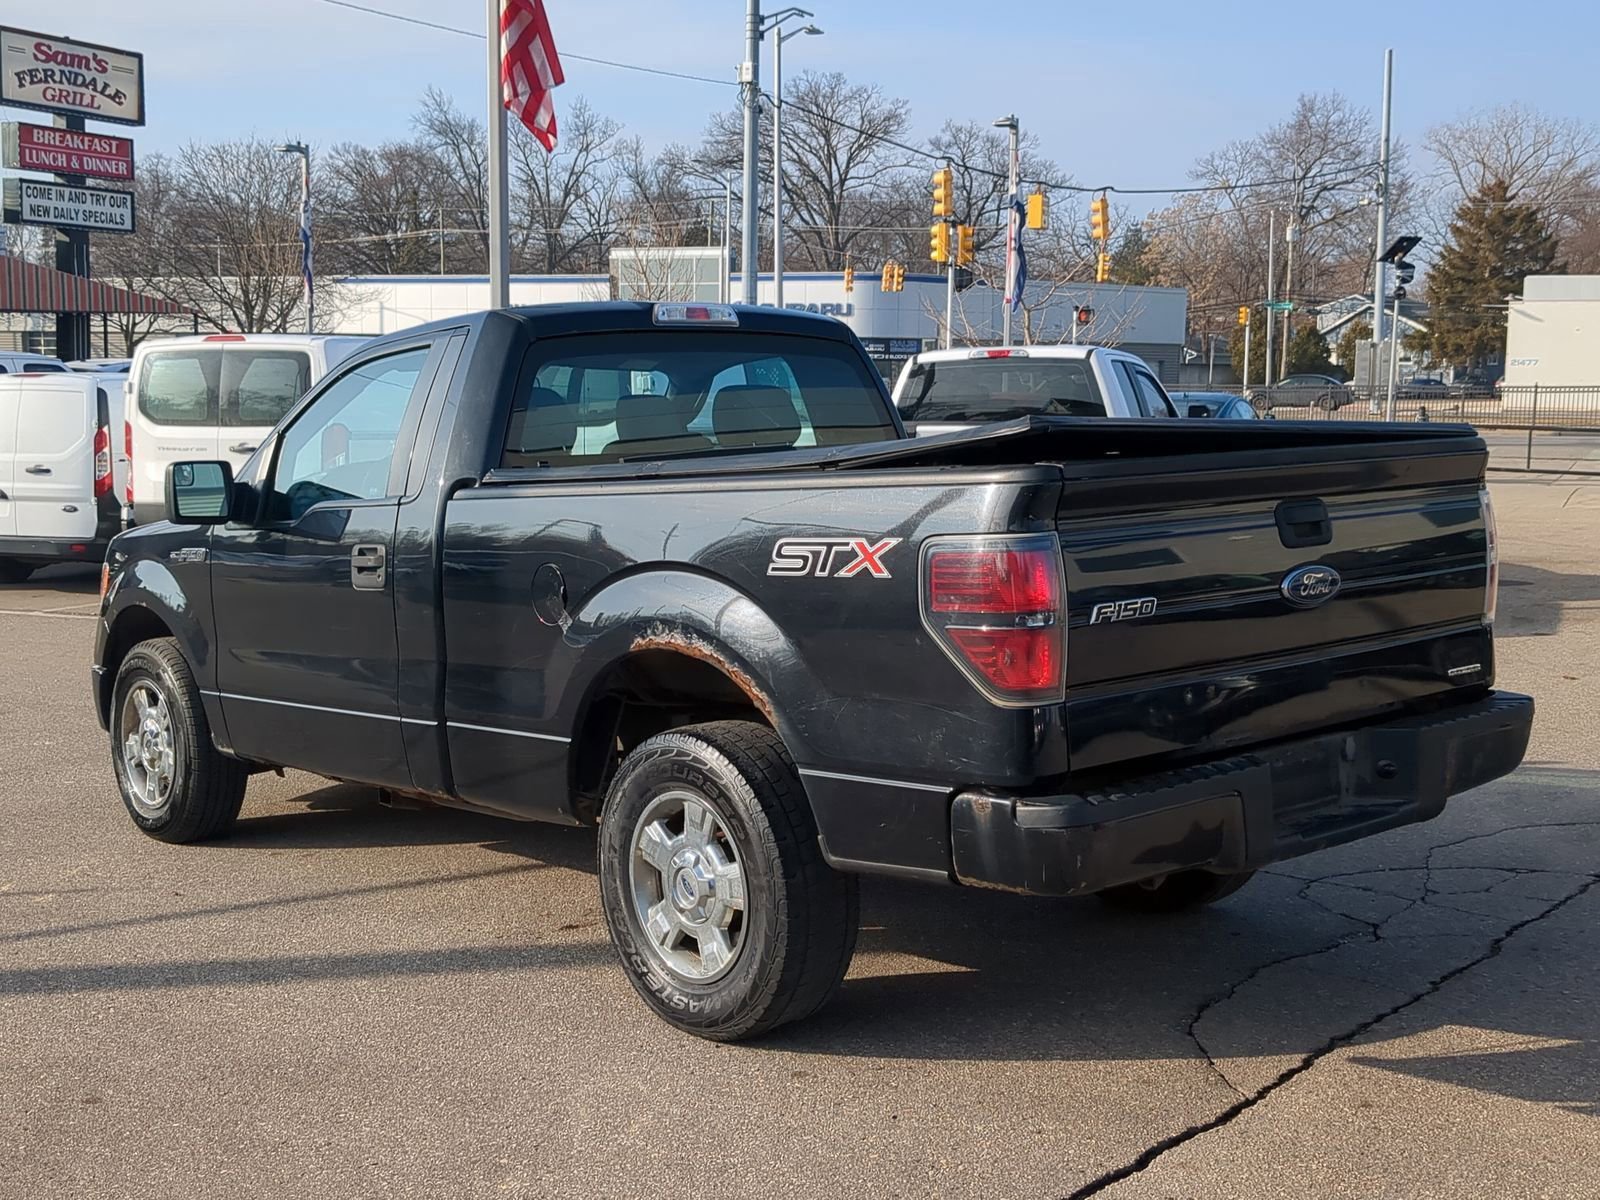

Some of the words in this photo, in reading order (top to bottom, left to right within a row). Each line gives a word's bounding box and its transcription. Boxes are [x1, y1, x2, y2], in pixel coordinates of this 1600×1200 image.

[33, 42, 109, 74] Sam's
[14, 68, 127, 106] FERNDALE
[42, 86, 101, 110] GRILL
[32, 128, 119, 154] BREAKFAST
[25, 148, 67, 167] LUNCH
[70, 155, 80, 169] &
[83, 156, 127, 175] DINNER
[25, 185, 53, 200] COME
[55, 188, 65, 202] IN
[68, 190, 87, 205] AND
[89, 193, 107, 207] TRY
[109, 196, 128, 209] OUR
[29, 204, 51, 218] NEW
[53, 206, 80, 221] DAILY
[82, 209, 125, 226] SPECIALS
[766, 537, 903, 578] STX
[1300, 573, 1333, 597] Ford
